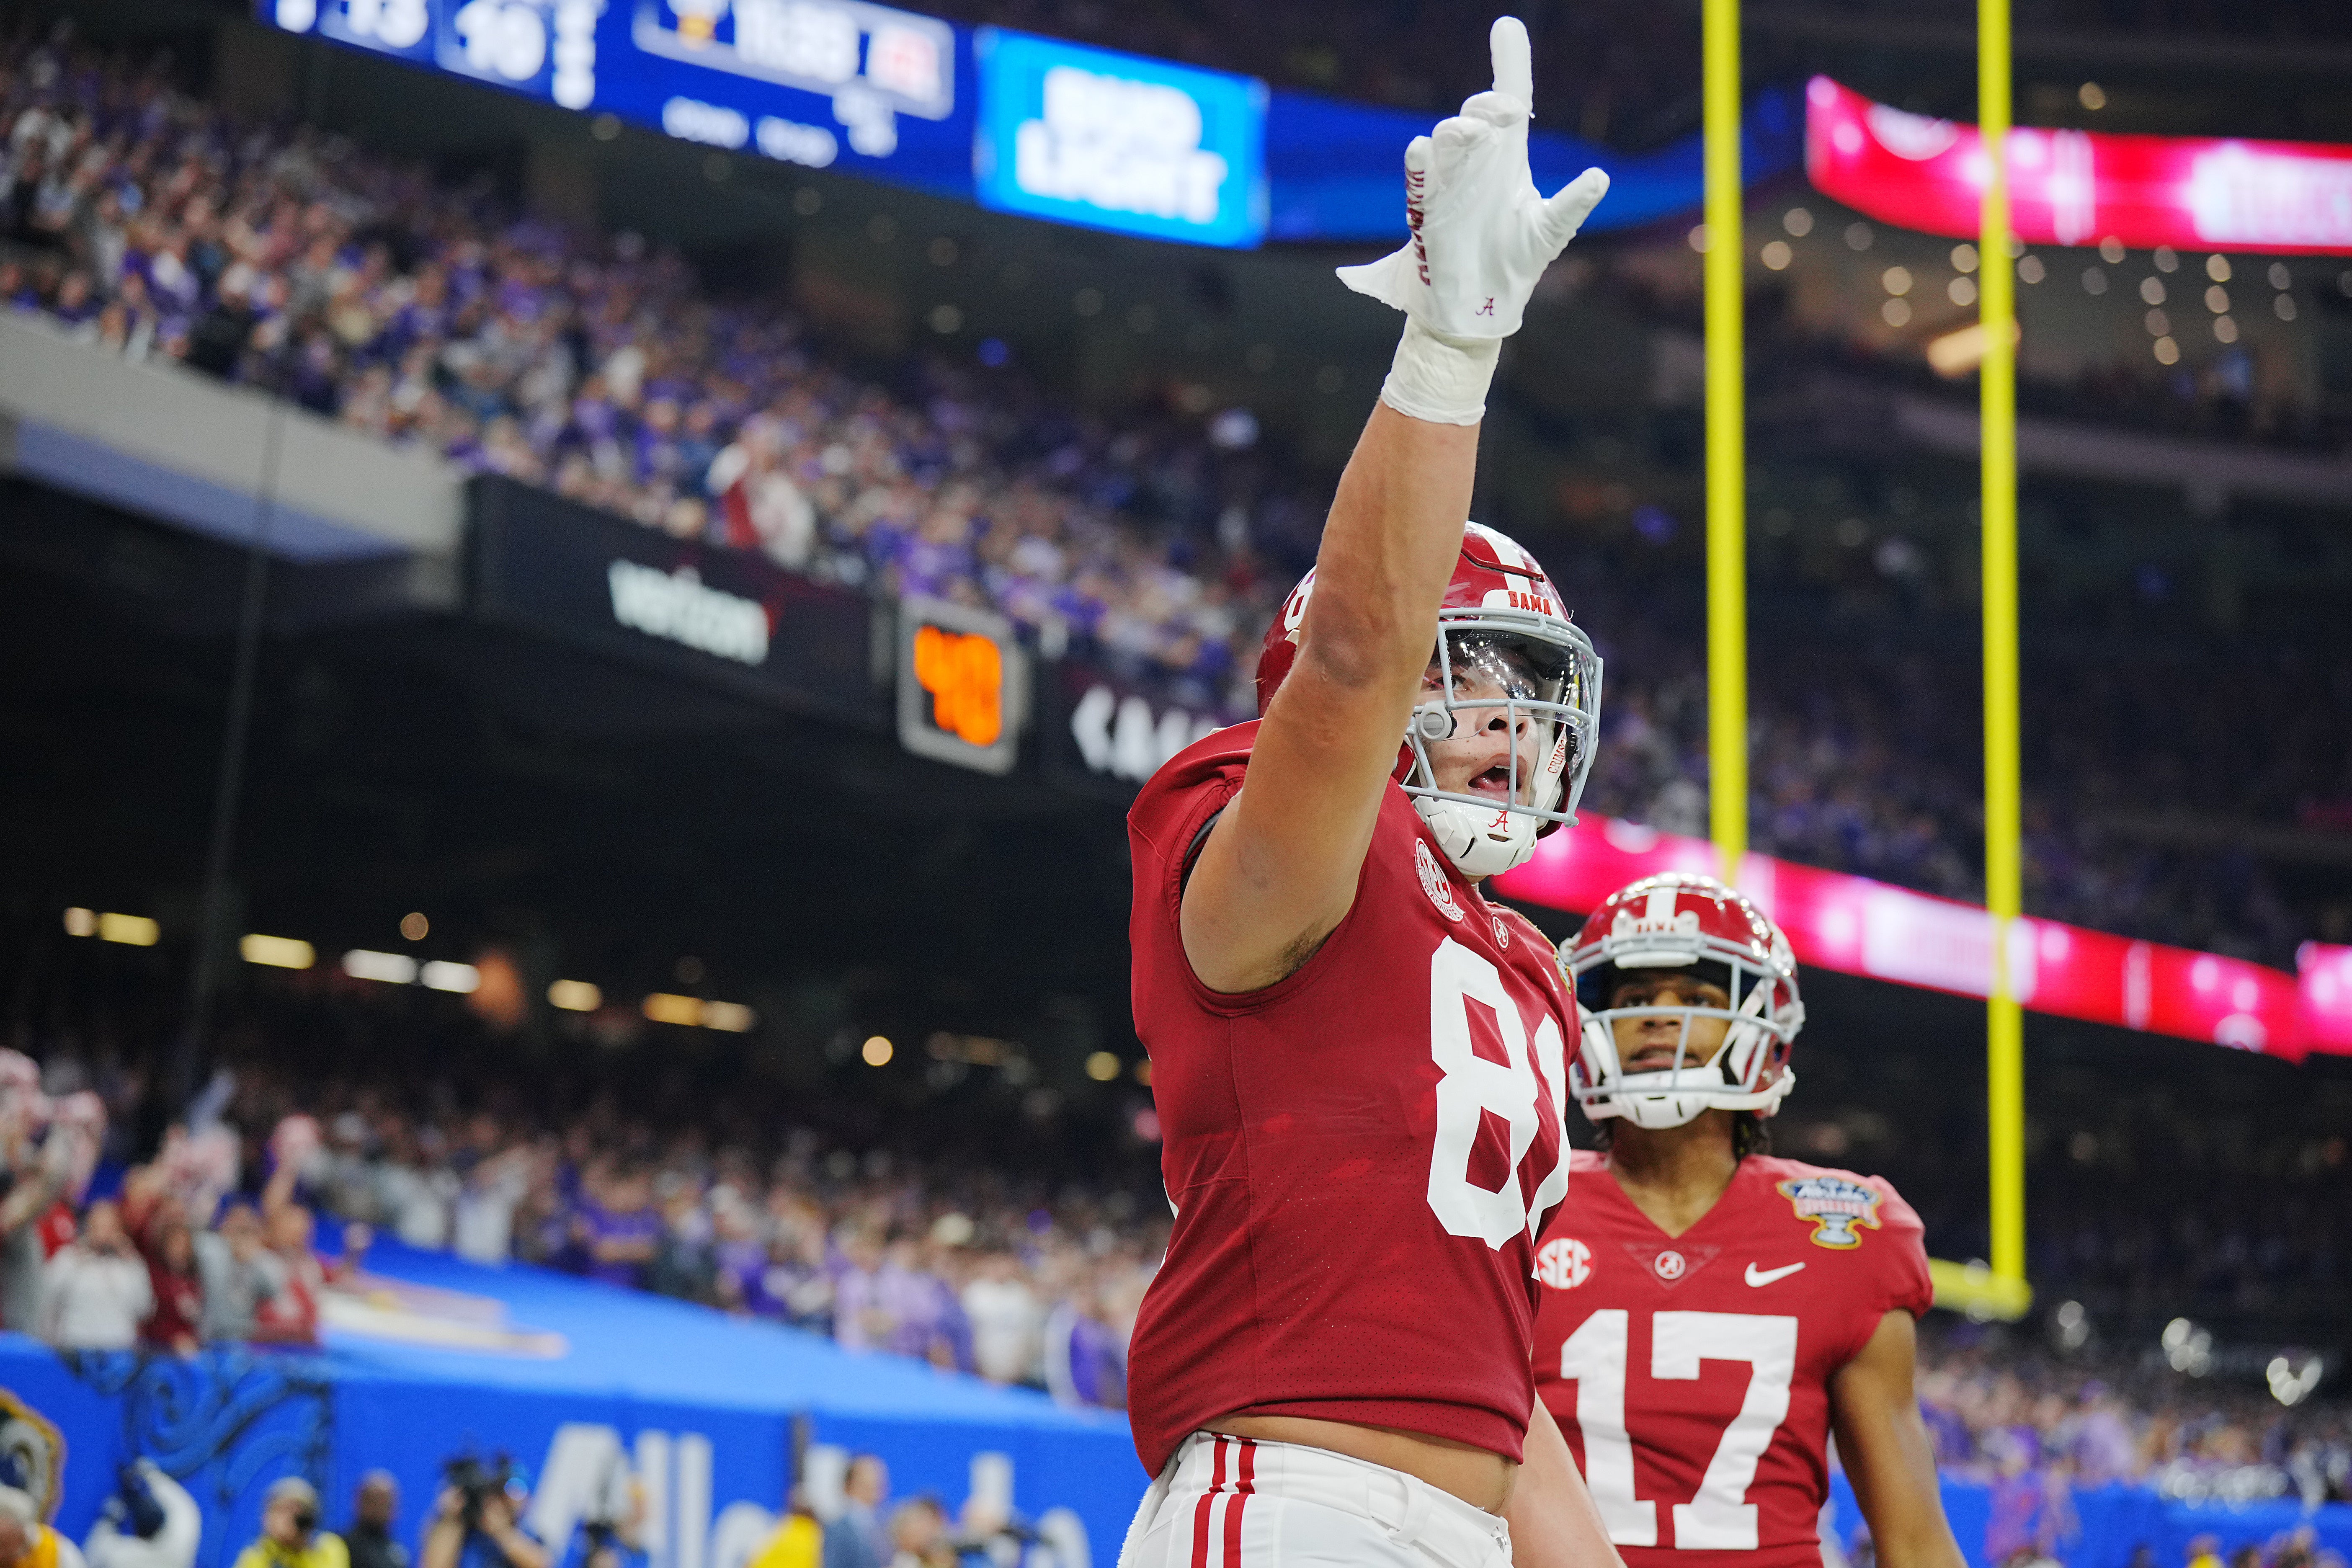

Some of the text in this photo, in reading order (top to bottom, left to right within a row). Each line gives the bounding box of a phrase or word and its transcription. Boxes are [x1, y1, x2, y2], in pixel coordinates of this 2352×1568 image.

[1508, 591, 1552, 616] BAMA
[1547, 734, 1565, 774] CRIMS
[1488, 809, 1509, 833] A
[1538, 1237, 1591, 1290] SEC
[1560, 1309, 1798, 1550] 17
